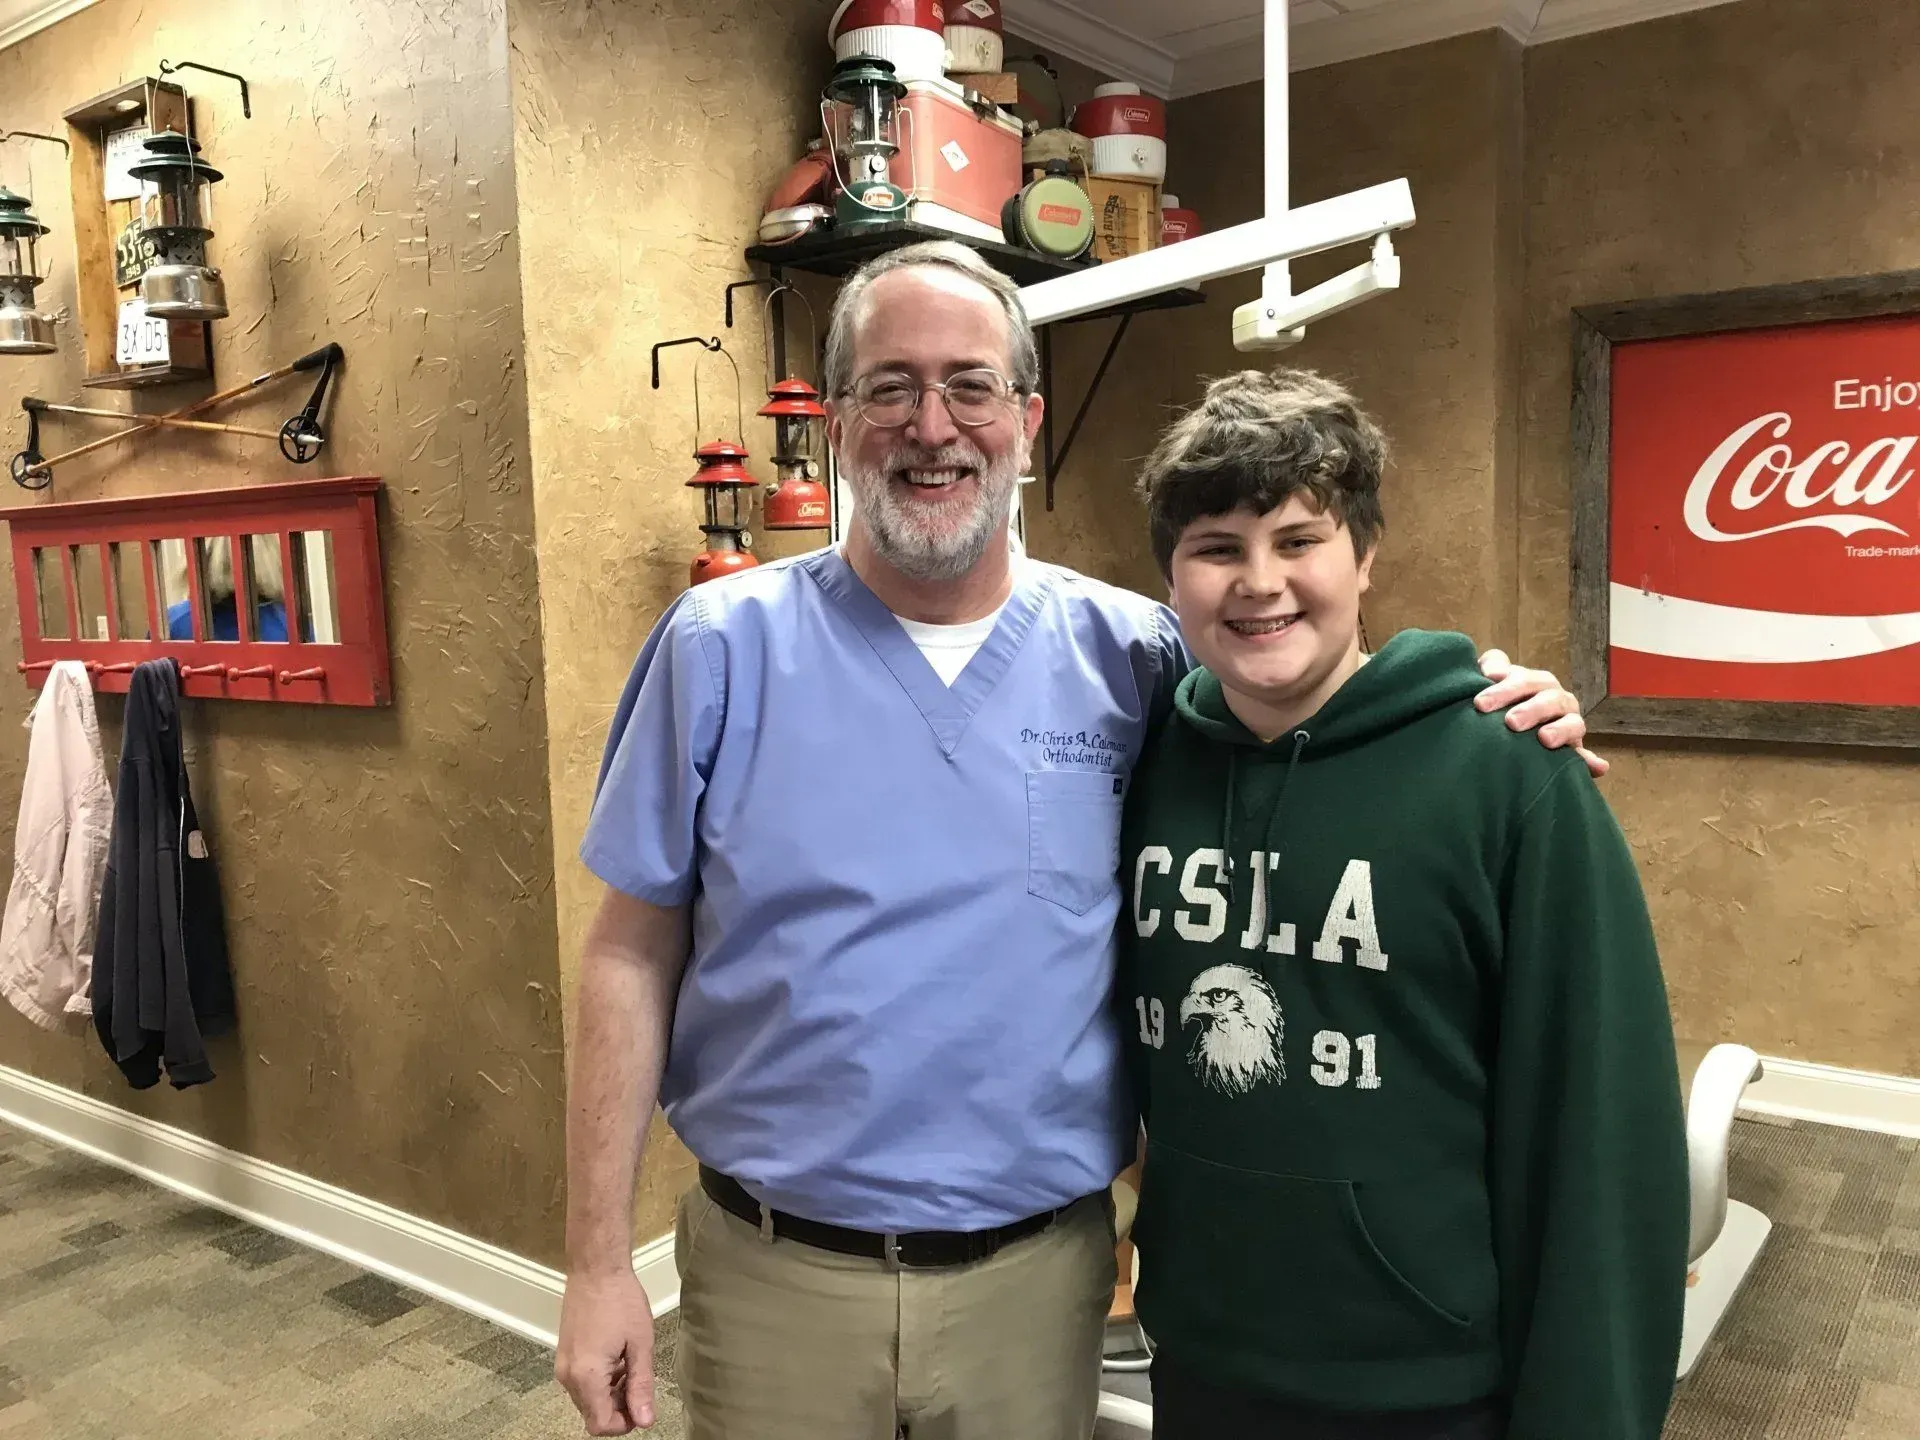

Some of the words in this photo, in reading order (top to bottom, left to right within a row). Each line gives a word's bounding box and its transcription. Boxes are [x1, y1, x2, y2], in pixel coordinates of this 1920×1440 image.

[1834, 376, 1920, 412] Enjo
[1683, 411, 1920, 542] Coca
[1042, 747, 1113, 767] Orthodontist
[1134, 845, 1389, 972] CSLA
[1135, 995, 1165, 1050] 19
[1310, 1029, 1382, 1090] 91
